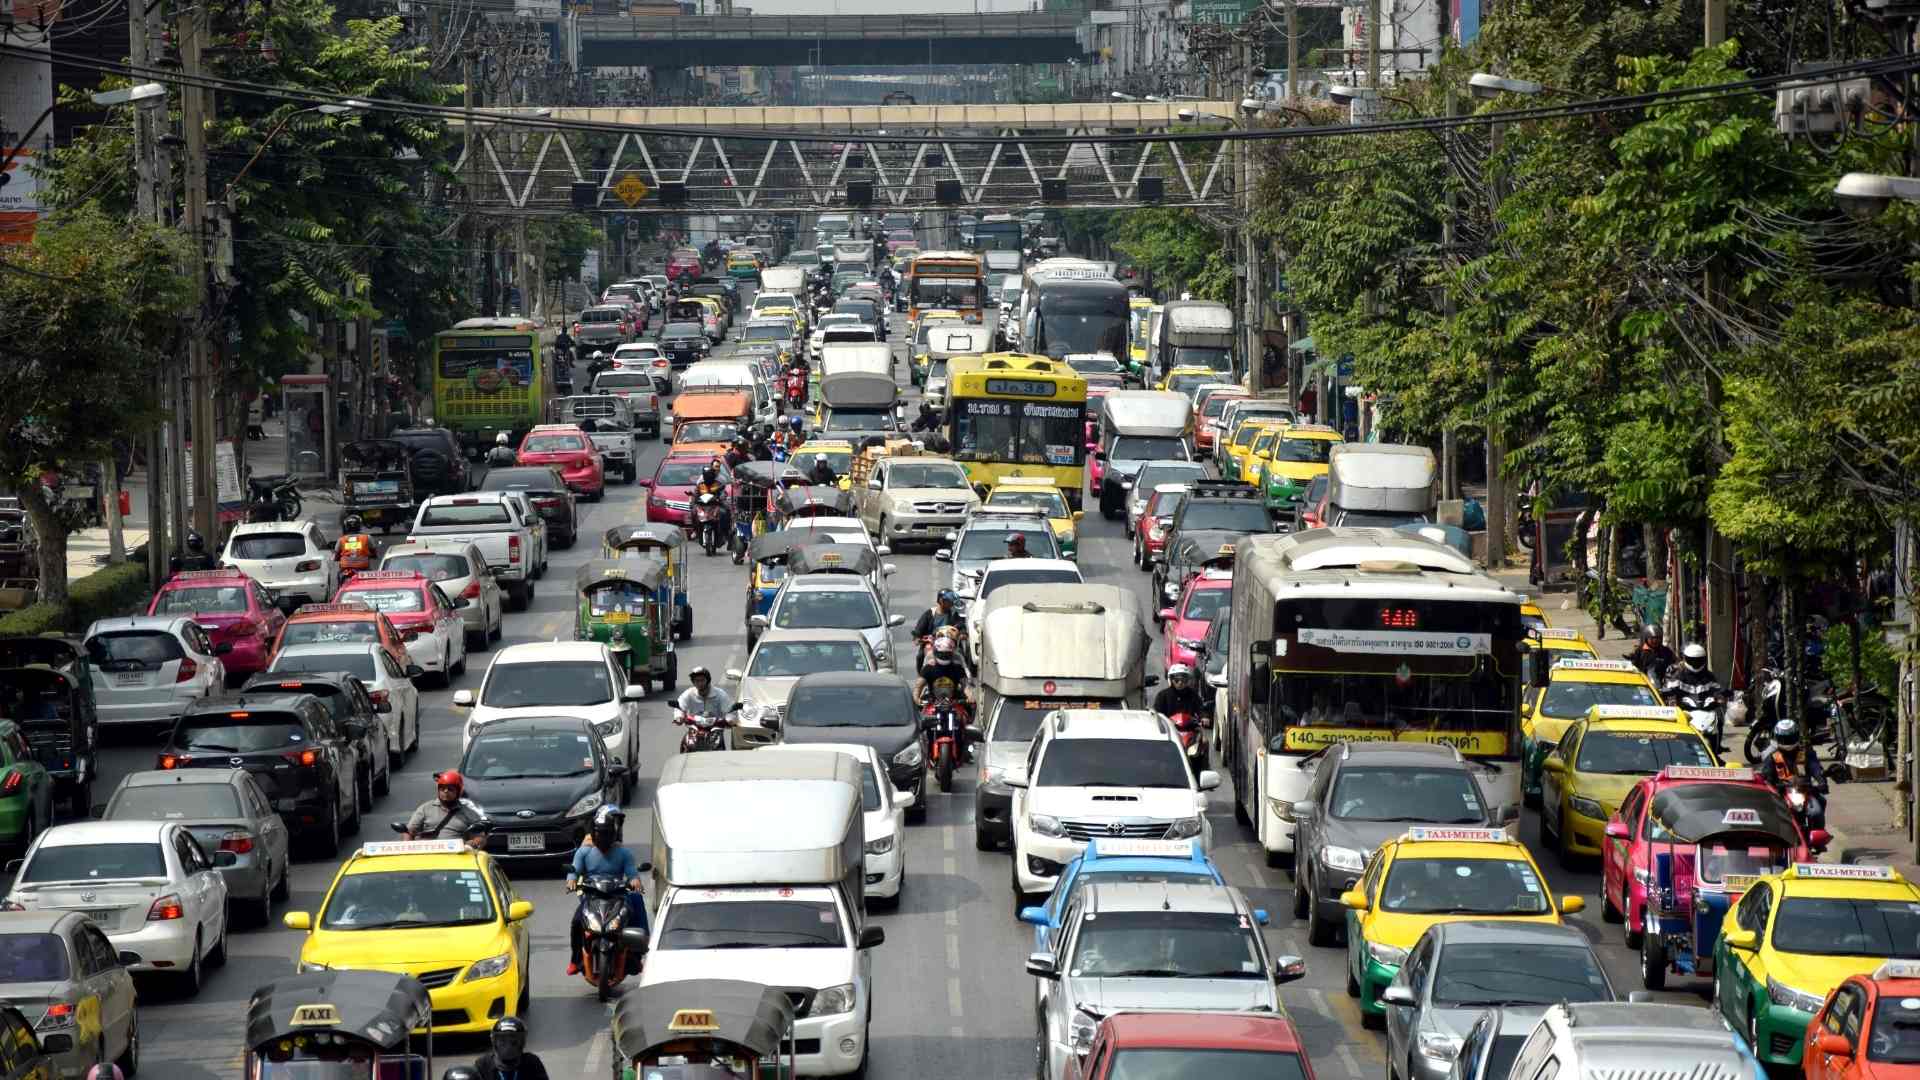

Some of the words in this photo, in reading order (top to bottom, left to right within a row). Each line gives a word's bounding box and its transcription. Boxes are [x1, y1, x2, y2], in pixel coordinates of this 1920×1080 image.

[1381, 608, 1417, 626] 140
[1290, 731, 1314, 743] 140
[1731, 811, 1754, 821] TAXI
[1426, 831, 1490, 839] TAXI-METER
[1812, 867, 1878, 877] TAXI-METER
[301, 1008, 331, 1020] TAXI
[679, 1014, 709, 1025] TAXI
